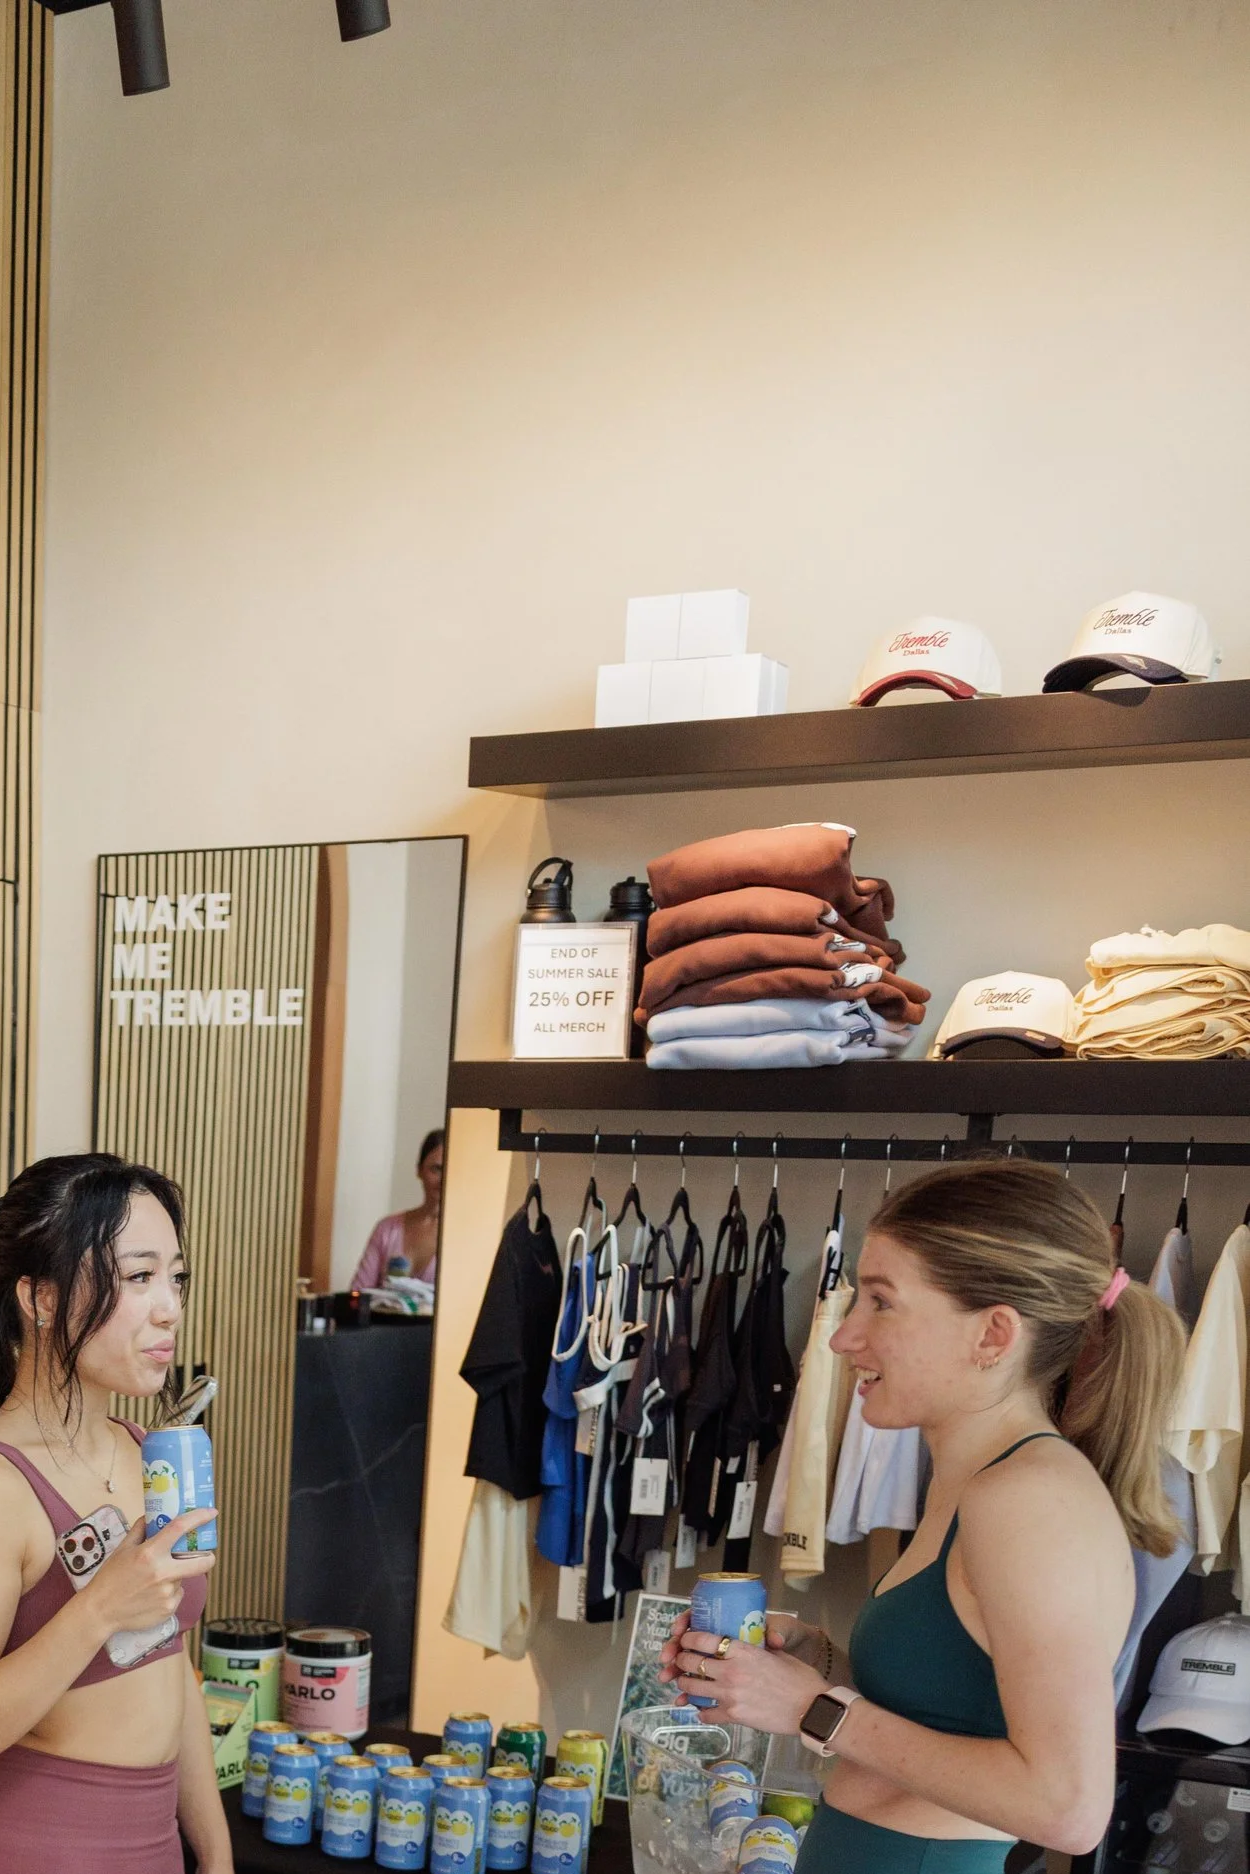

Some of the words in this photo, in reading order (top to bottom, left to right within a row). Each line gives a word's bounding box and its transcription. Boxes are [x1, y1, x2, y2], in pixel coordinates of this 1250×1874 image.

[1093, 608, 1161, 630] Tremble
[1104, 626, 1133, 636] Dallas
[888, 631, 952, 653] Tremble
[902, 648, 931, 657] Dallas
[114, 892, 231, 932] MAKE
[112, 942, 172, 980] ME
[550, 948, 577, 959] END
[581, 948, 599, 958] OF
[528, 968, 584, 979] SUMMER
[587, 968, 619, 979] SALE
[529, 991, 570, 1007] 25%
[576, 991, 615, 1007] OFF
[974, 987, 1037, 1007] Tremble
[110, 988, 304, 1026] TREMBLE
[534, 1023, 555, 1033] ALL
[559, 1023, 606, 1033] MERCH
[1182, 1661, 1234, 1673] TREMBLE
